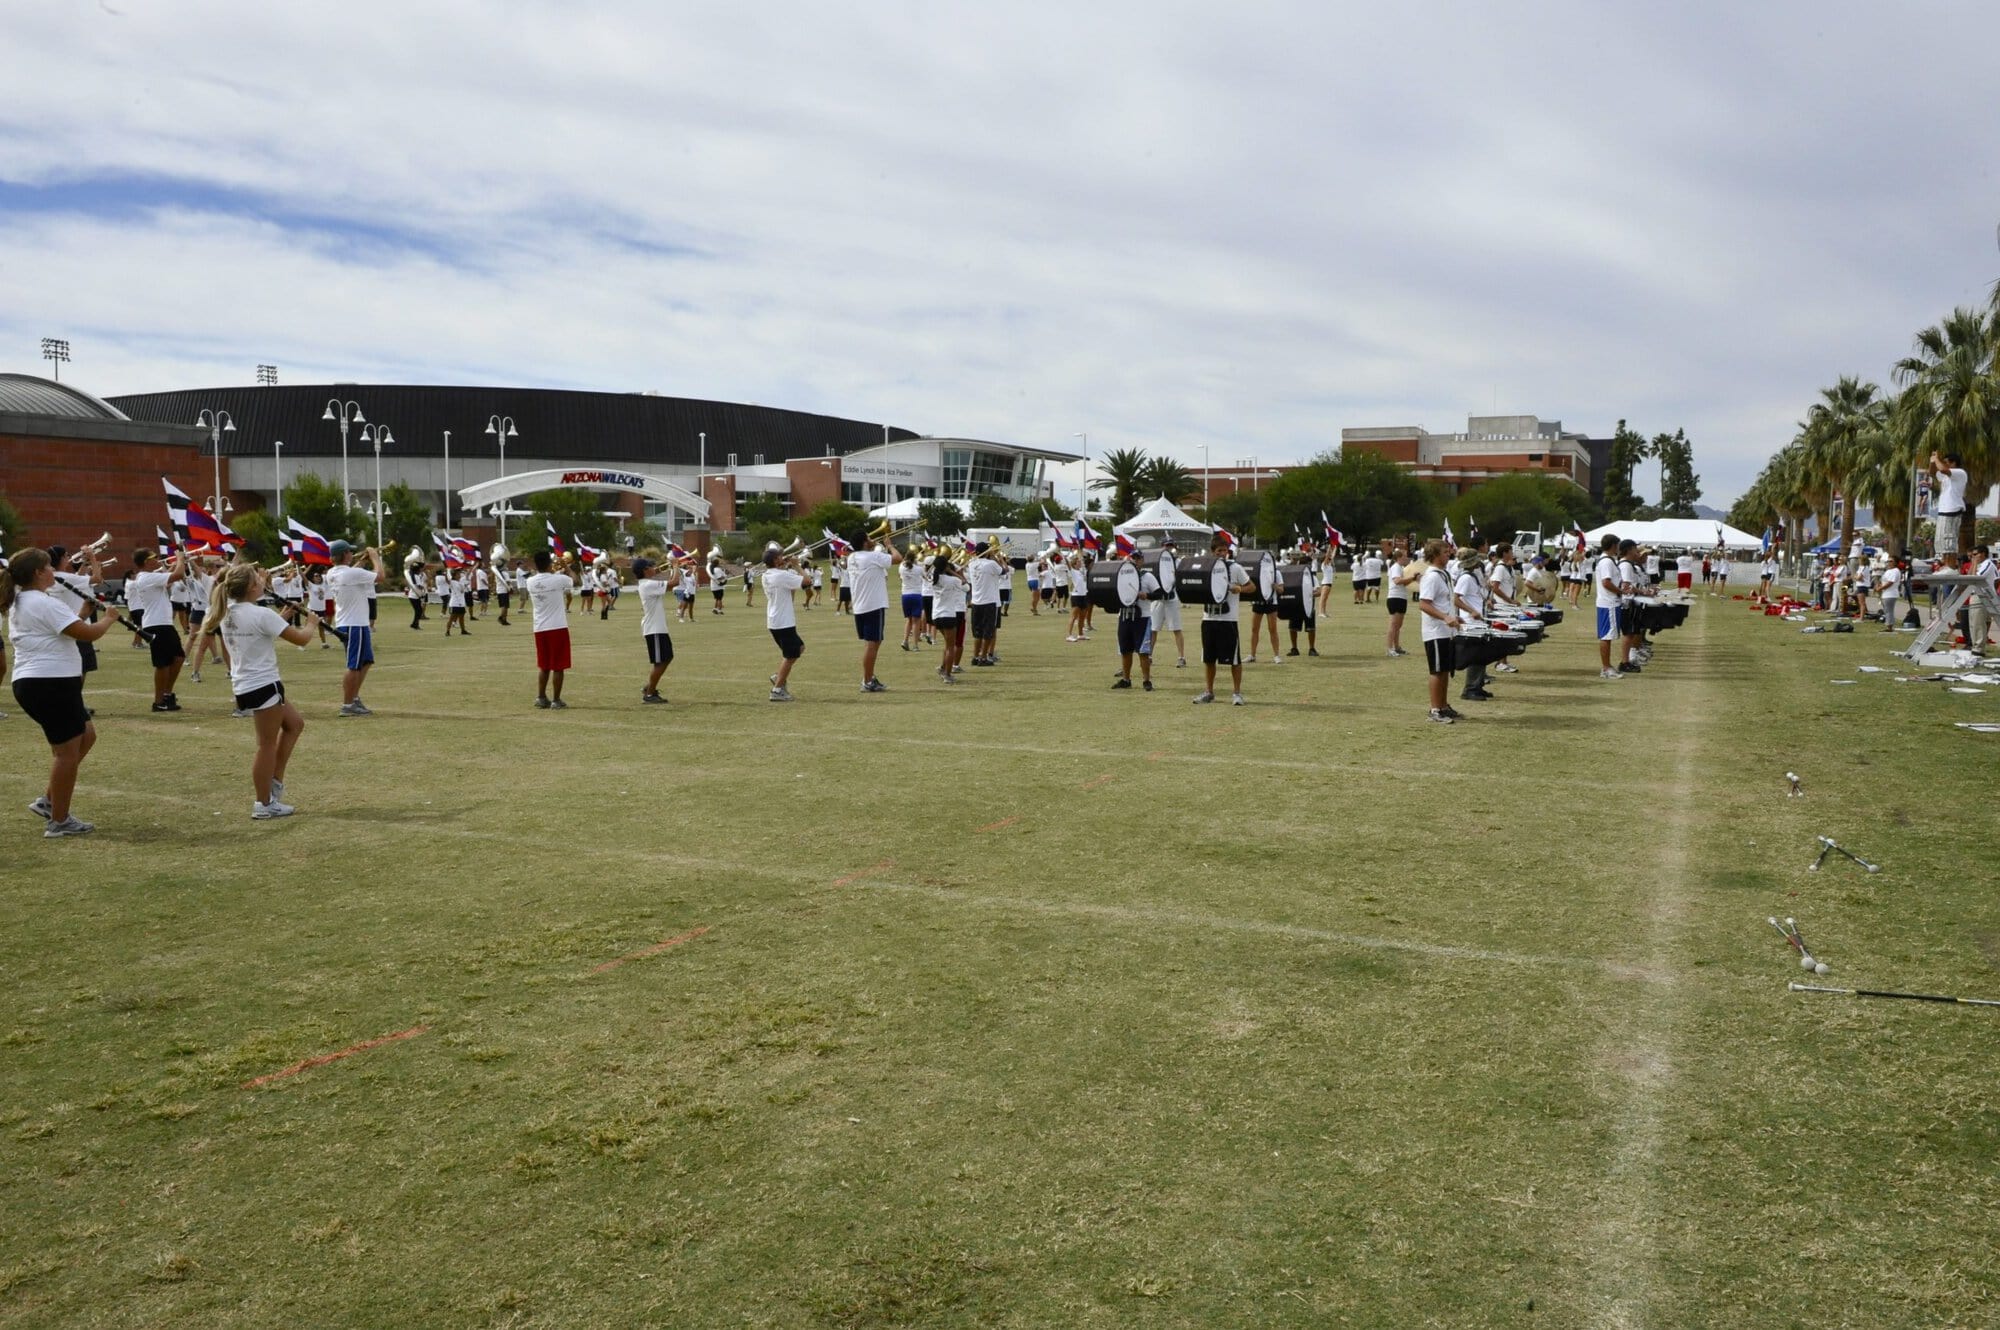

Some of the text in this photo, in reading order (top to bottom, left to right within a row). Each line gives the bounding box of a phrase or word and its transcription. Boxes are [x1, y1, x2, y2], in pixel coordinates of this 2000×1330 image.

[860, 467, 876, 475] Lynch
[561, 472, 645, 488] ARIZONA WILDCATS
